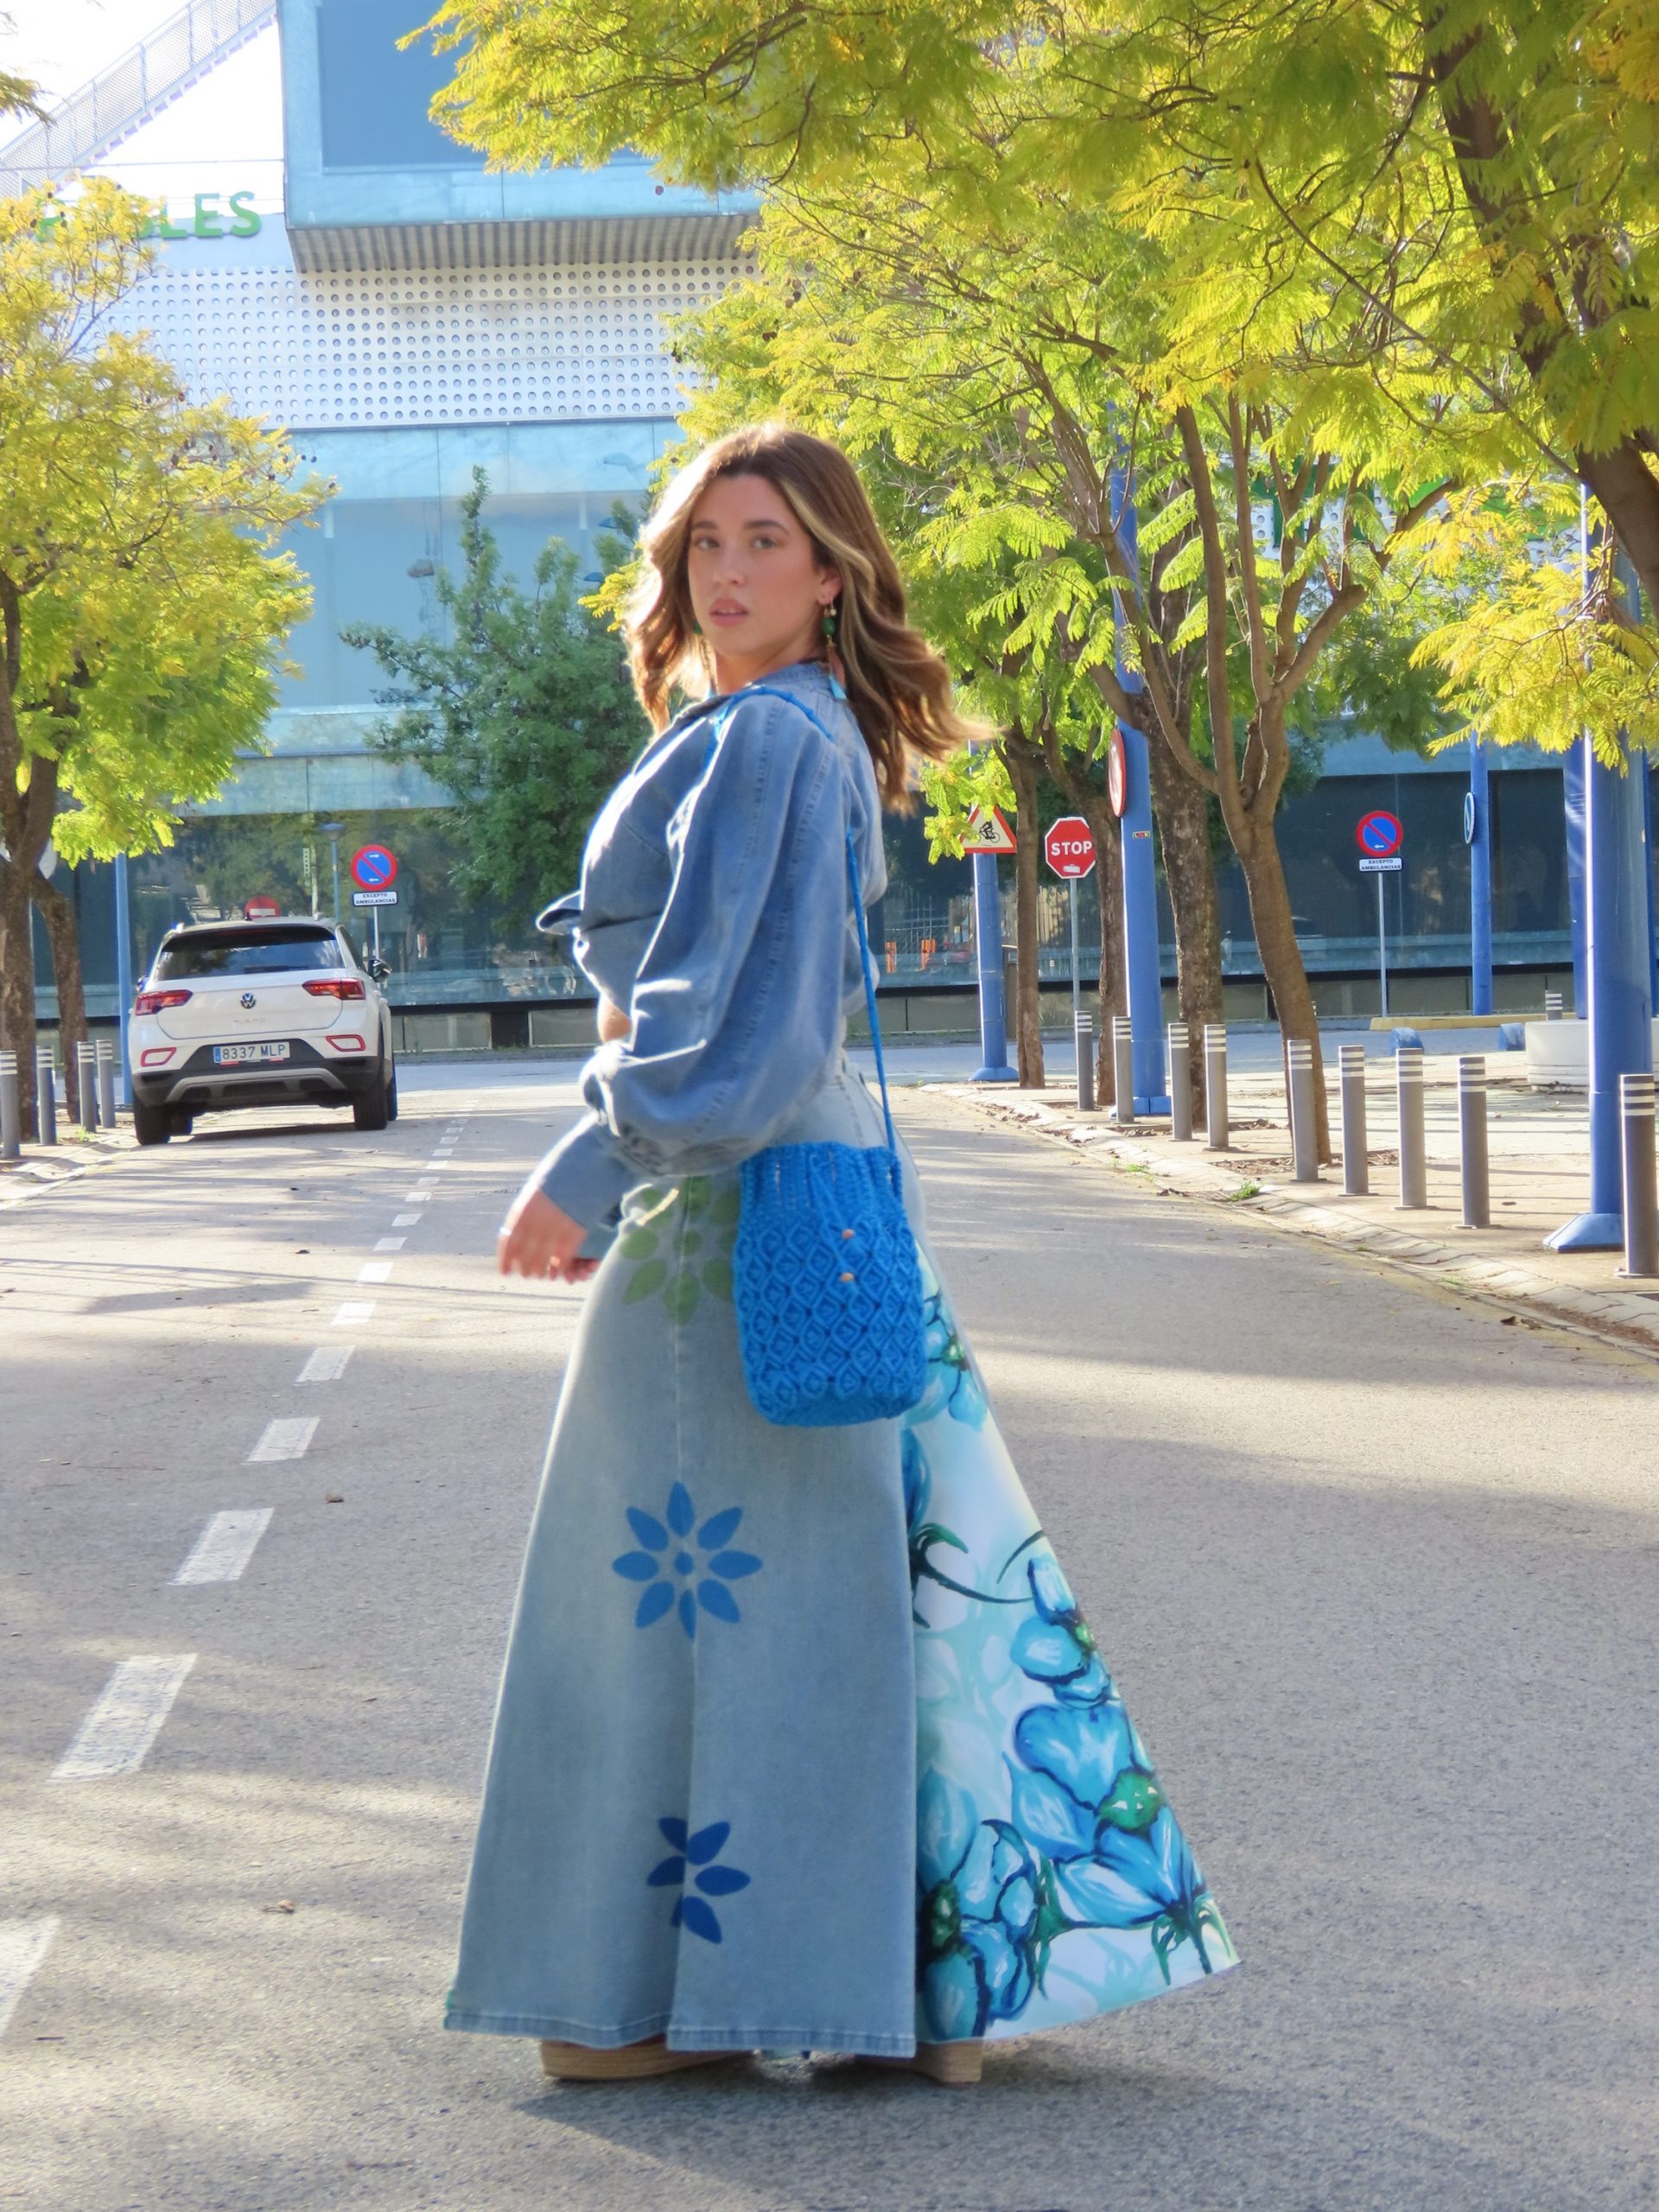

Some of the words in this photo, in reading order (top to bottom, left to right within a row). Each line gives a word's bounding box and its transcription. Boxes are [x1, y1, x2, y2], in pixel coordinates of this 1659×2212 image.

[1051, 841, 1092, 855] STOP
[222, 1046, 256, 1059] 8337
[260, 1044, 285, 1057] MLP
